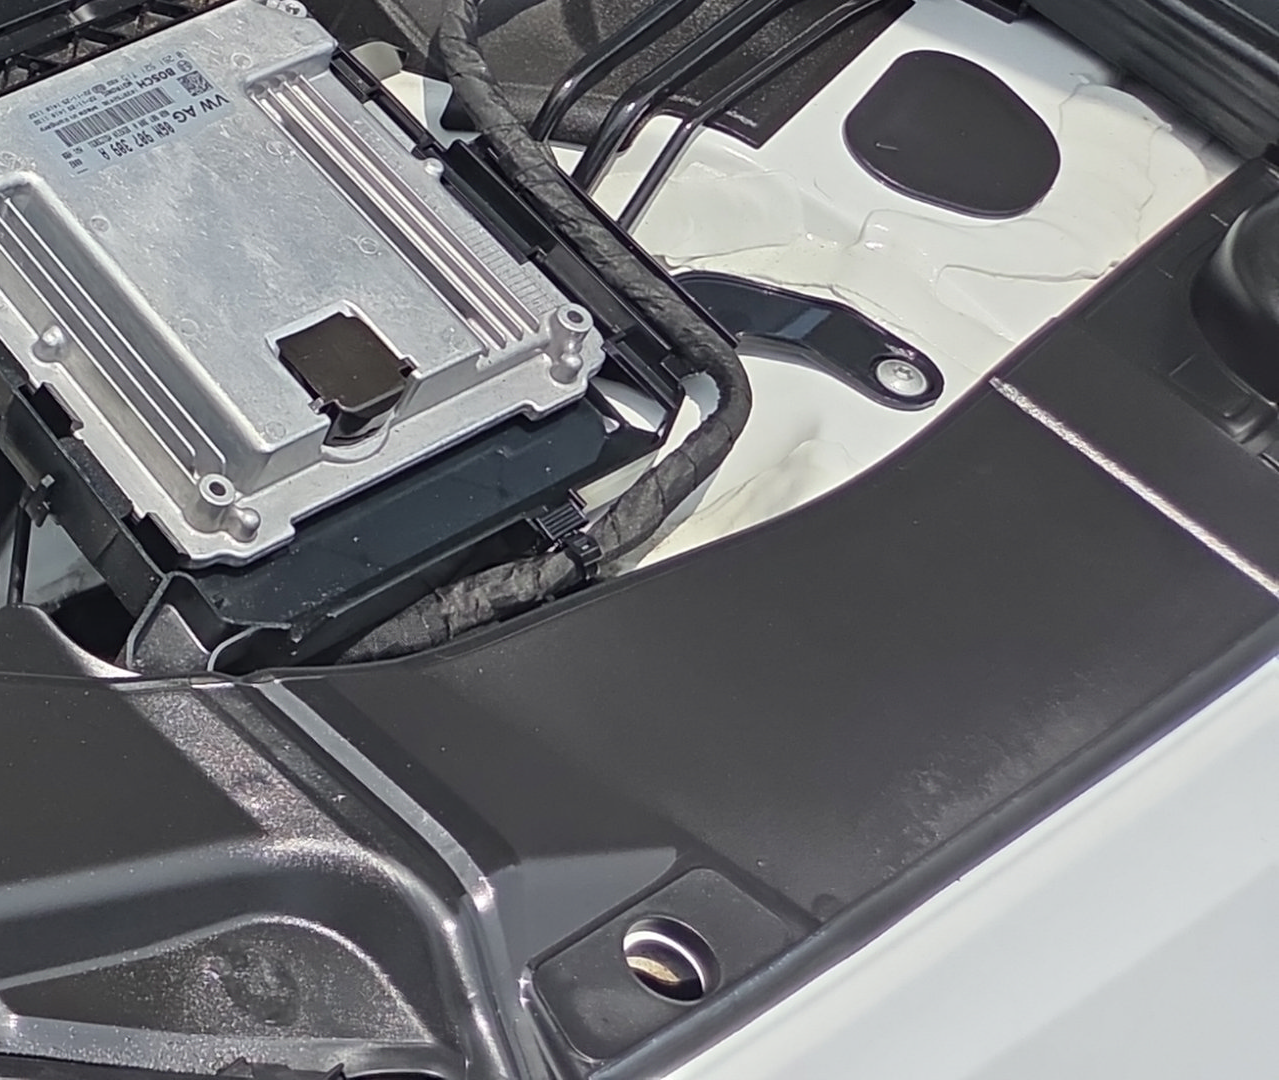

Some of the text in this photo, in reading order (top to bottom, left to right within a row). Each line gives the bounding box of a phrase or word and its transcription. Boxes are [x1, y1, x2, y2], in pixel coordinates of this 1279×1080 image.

[135, 66, 177, 89] BOSCH
[195, 91, 229, 113] VW
[169, 104, 200, 124] AG
